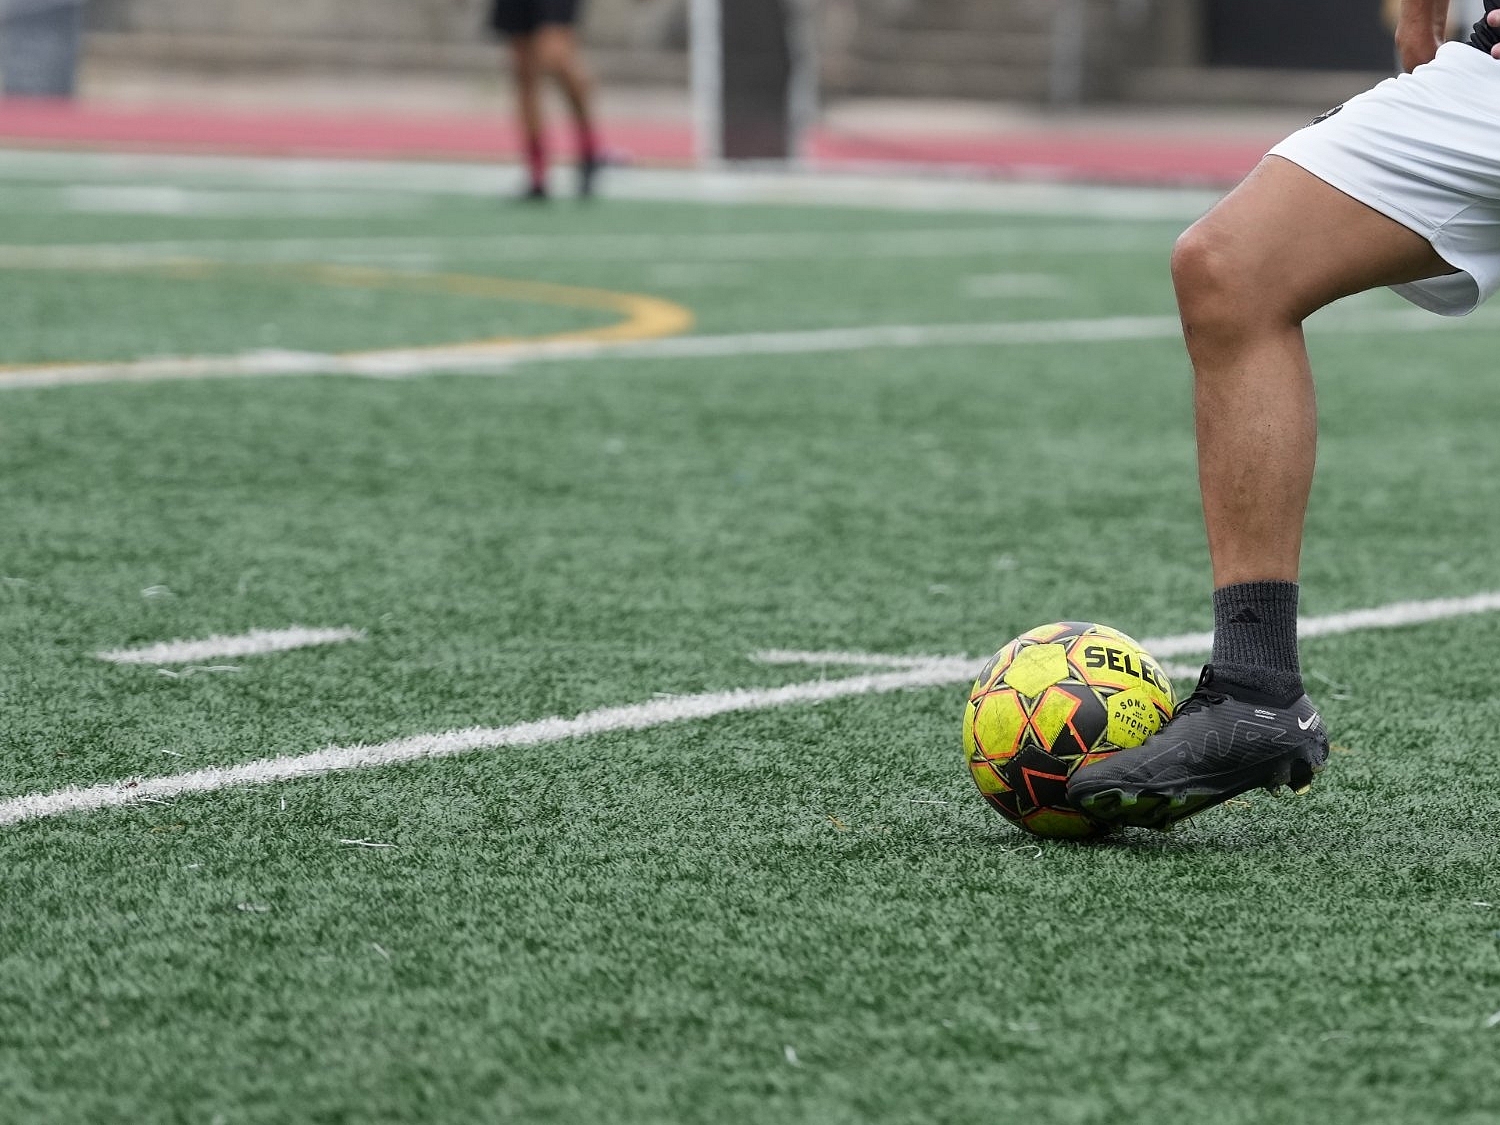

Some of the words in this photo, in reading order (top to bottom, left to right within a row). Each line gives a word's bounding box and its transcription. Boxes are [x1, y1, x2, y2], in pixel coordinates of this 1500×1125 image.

[1114, 711, 1153, 737] PITCHES
[1120, 698, 1146, 711] SONS
[1148, 713, 1155, 724] OF
